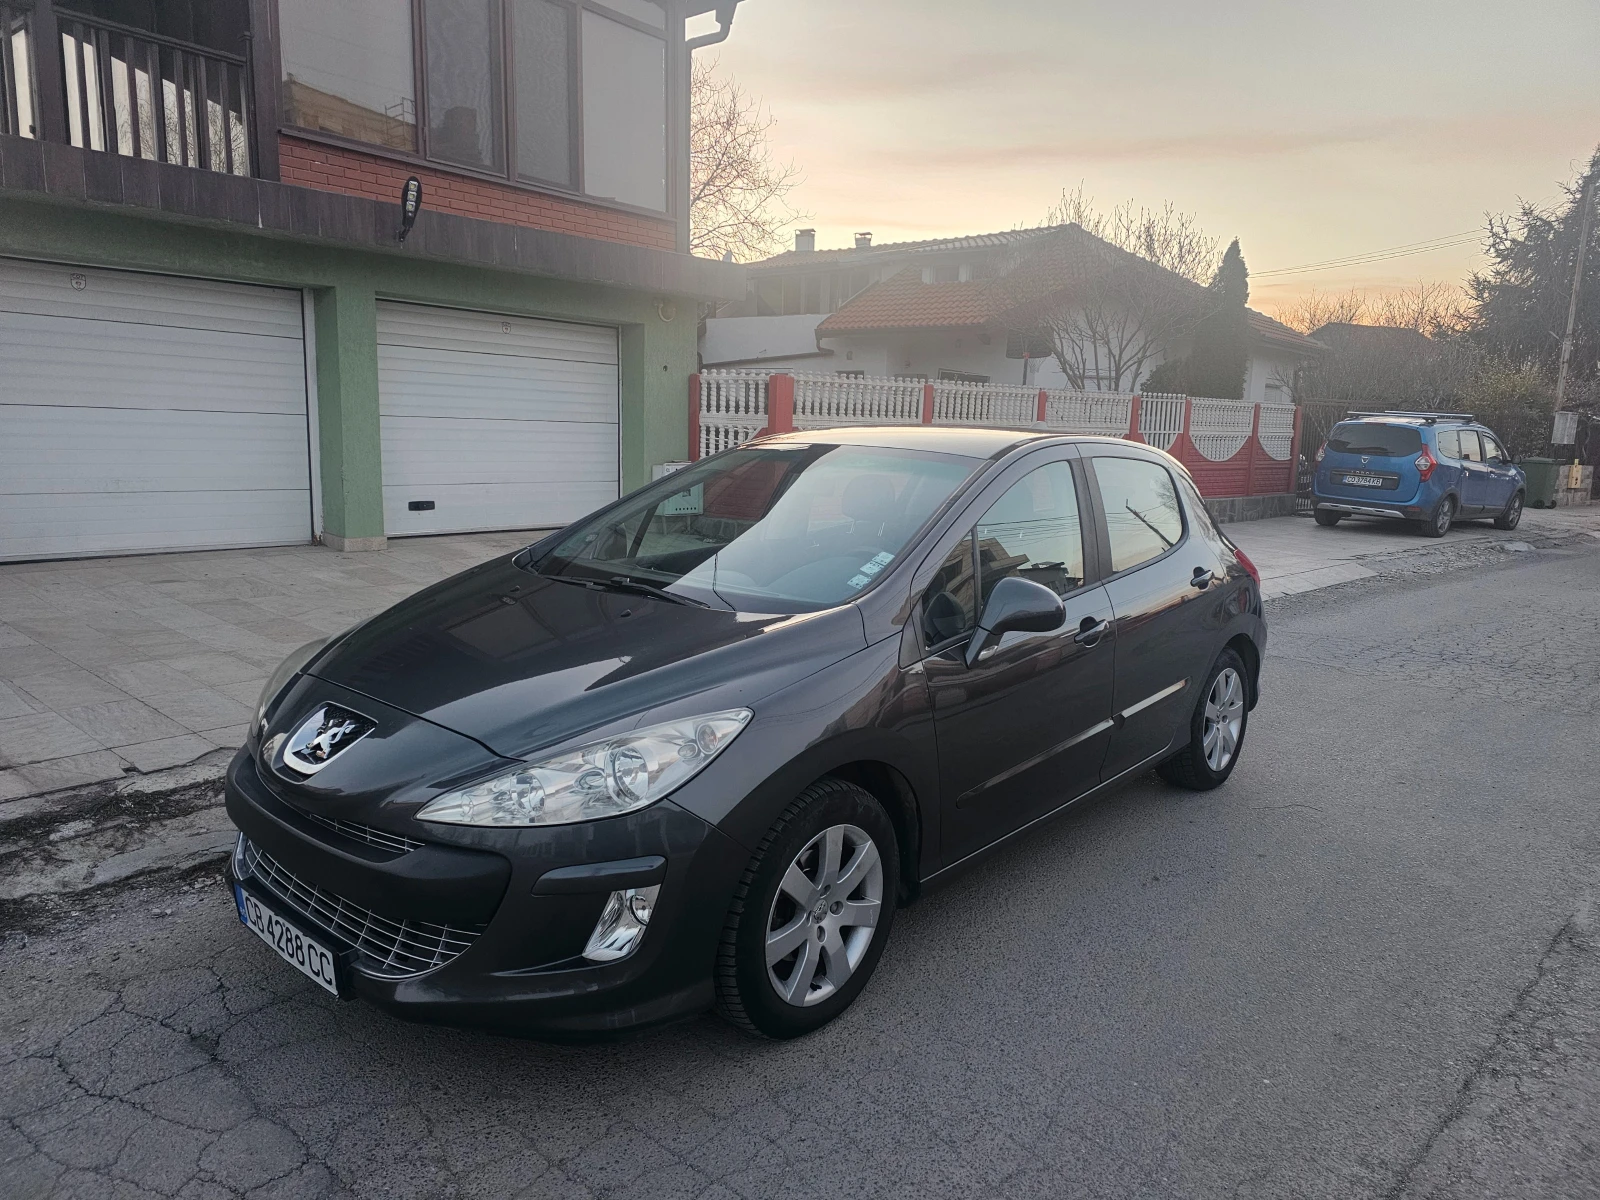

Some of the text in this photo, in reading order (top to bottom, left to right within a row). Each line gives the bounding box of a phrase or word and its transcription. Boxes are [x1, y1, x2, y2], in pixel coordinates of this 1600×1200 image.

[245, 896, 333, 986] CB 4288 CC
